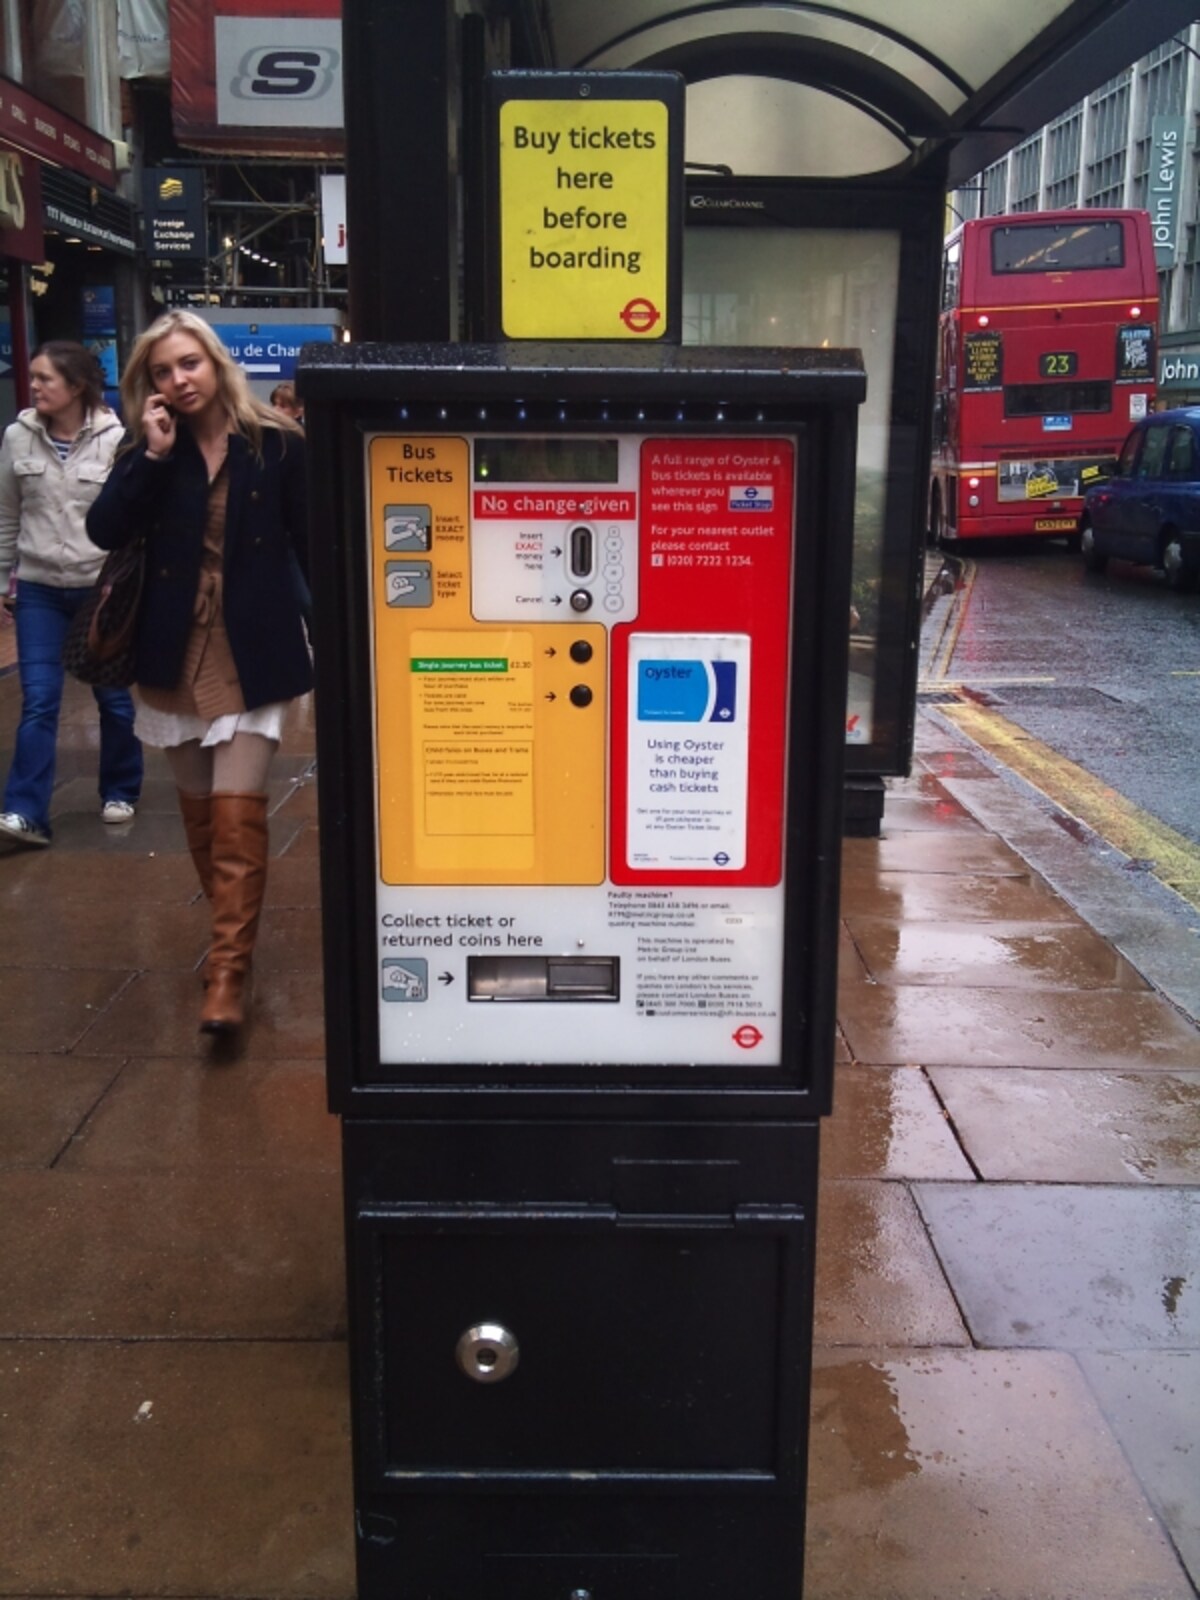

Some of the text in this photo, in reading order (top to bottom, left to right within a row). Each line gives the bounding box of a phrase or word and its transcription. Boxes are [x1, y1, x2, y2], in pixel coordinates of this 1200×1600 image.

[514, 127, 656, 154] Buy tickets
[557, 166, 613, 189] here
[1151, 130, 1177, 250] John Lewis
[153, 219, 185, 229] Foreign
[543, 206, 627, 229] before
[153, 230, 195, 240] Exchange
[154, 241, 191, 250] Services
[530, 246, 641, 273] boarding
[244, 343, 263, 356] de
[1046, 356, 1071, 374] 23
[1160, 358, 1199, 385] John
[402, 444, 436, 460] Bus
[651, 455, 661, 465] A
[663, 455, 682, 465] full
[684, 457, 715, 468] range
[718, 455, 729, 465] of
[732, 455, 770, 468] Oyster
[386, 467, 453, 483] Tickets
[651, 470, 773, 481] bus tickets is available
[651, 486, 725, 499] wherever you
[481, 496, 630, 515] No change given
[651, 500, 718, 514] see this sign
[519, 532, 543, 541] Insert
[651, 525, 774, 537] For your nearest outlet
[515, 543, 543, 551] EXACT
[651, 540, 730, 552] please contact
[515, 552, 543, 561] money
[696, 555, 720, 566] 7222
[437, 571, 462, 579] Select
[437, 580, 461, 589] ticket
[437, 590, 457, 599] type
[515, 595, 544, 604] Cancel
[647, 739, 724, 752] Using Oyster
[655, 754, 715, 767] is cheaper
[649, 768, 719, 782] than buying
[649, 782, 719, 794] cash tickets
[382, 913, 516, 928] Collect ticket or
[382, 933, 543, 947] returned coins here
